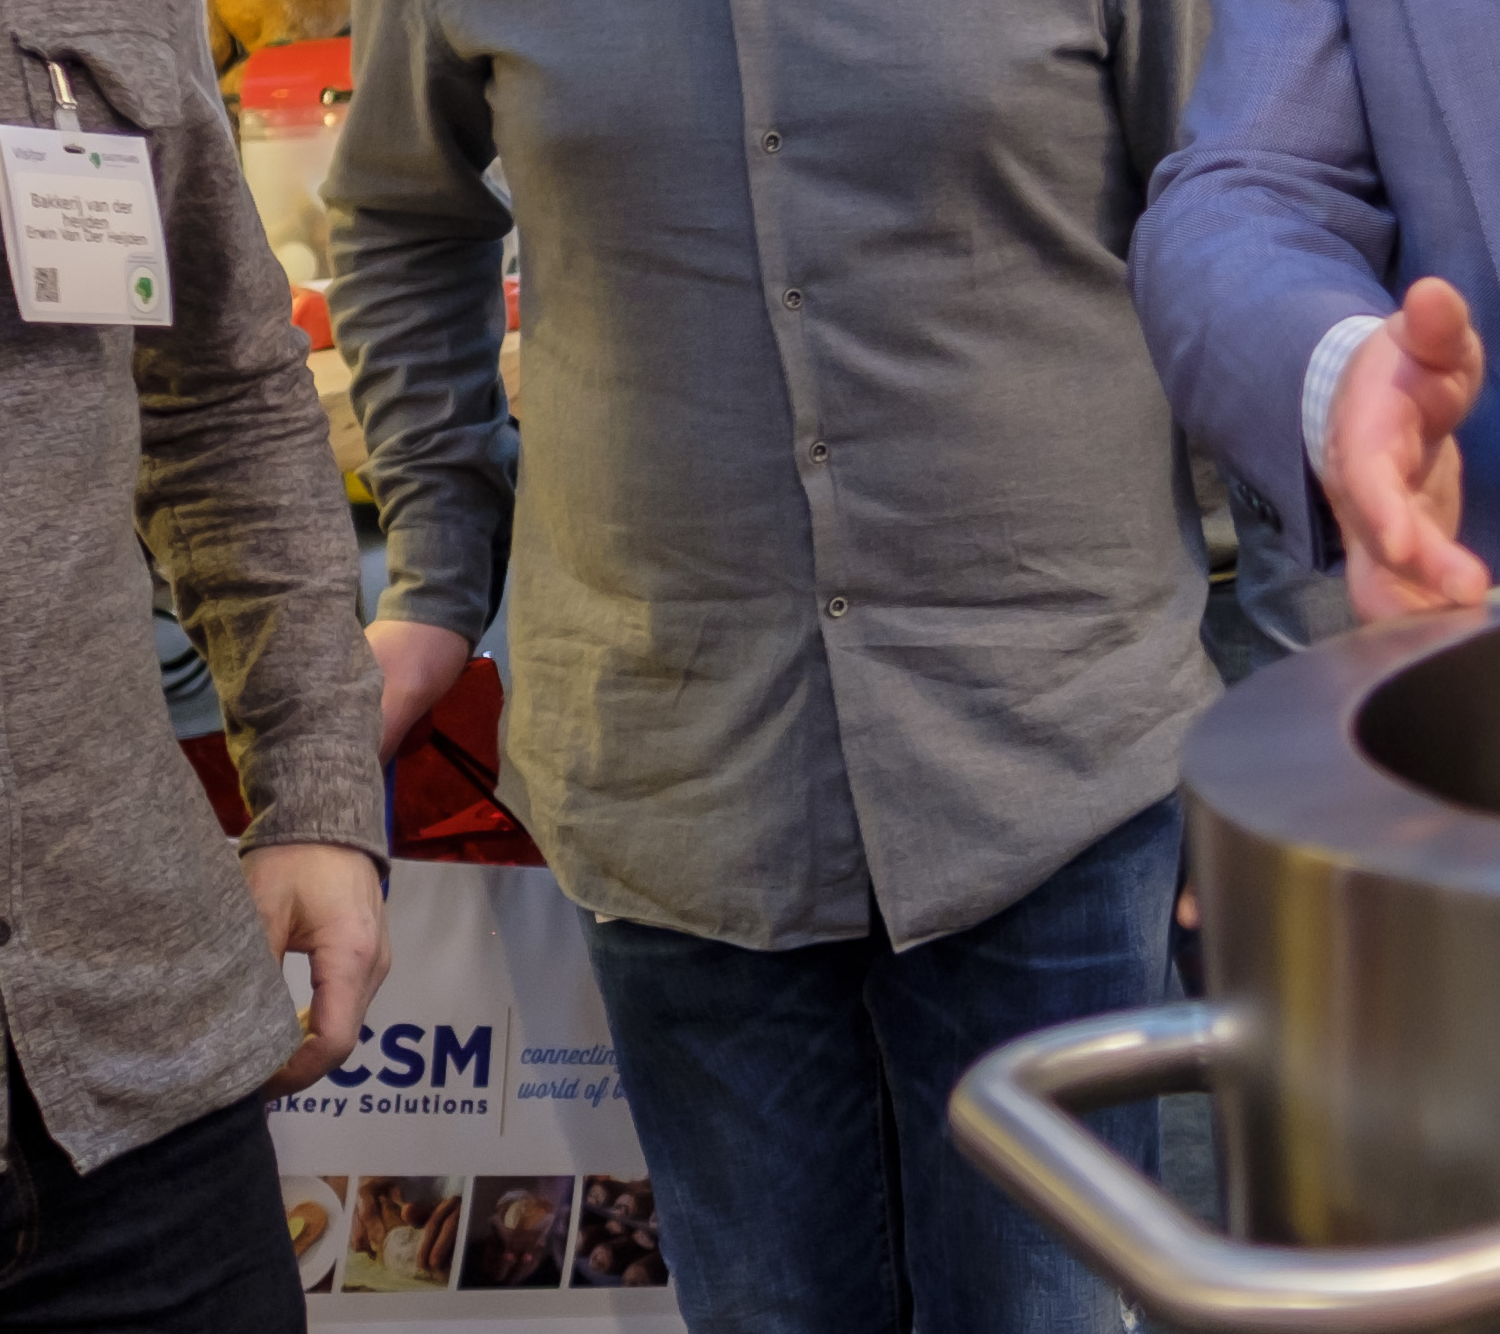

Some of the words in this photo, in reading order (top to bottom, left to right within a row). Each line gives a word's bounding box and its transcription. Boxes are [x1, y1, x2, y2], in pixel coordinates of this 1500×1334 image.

[30, 192, 83, 216] Bakkerij
[85, 200, 110, 213] van
[112, 199, 132, 214] der
[520, 1044, 622, 1067] connectin
[517, 1077, 580, 1100] world
[584, 1077, 609, 1109] of
[270, 1094, 348, 1118] akery
[358, 1093, 488, 1115] Solutions
